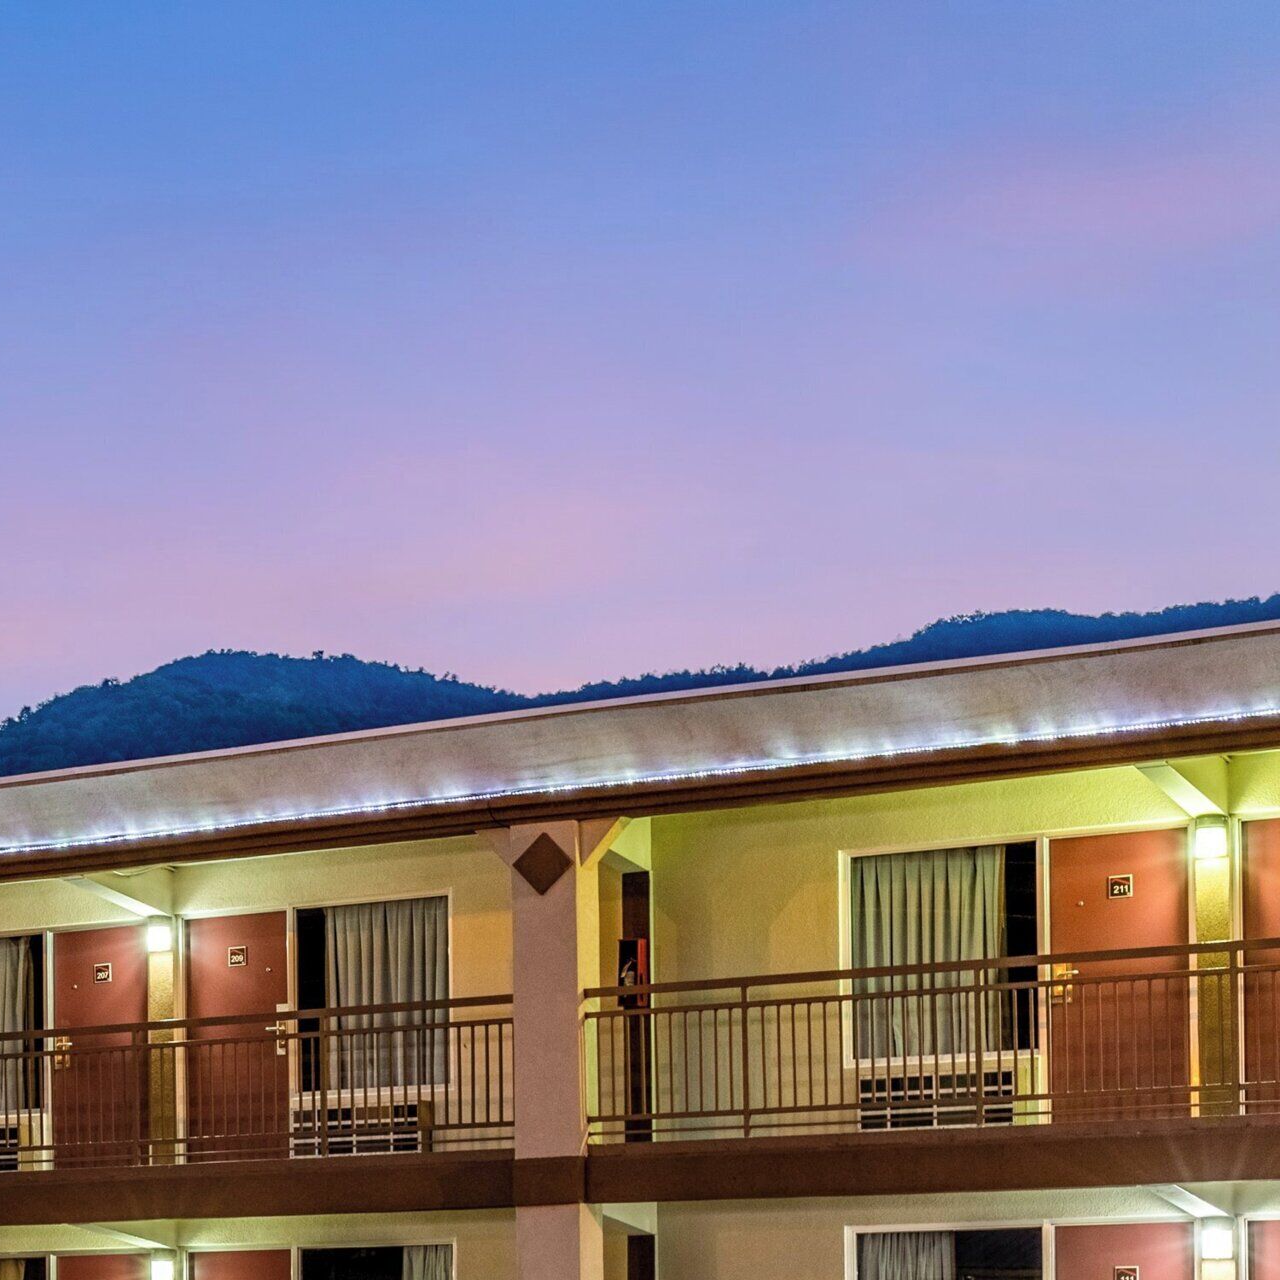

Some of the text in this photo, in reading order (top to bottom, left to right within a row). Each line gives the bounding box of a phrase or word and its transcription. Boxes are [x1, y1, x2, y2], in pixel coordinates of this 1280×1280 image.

[1113, 884, 1129, 894] 211
[230, 954, 244, 963] 209
[96, 971, 109, 980] 207
